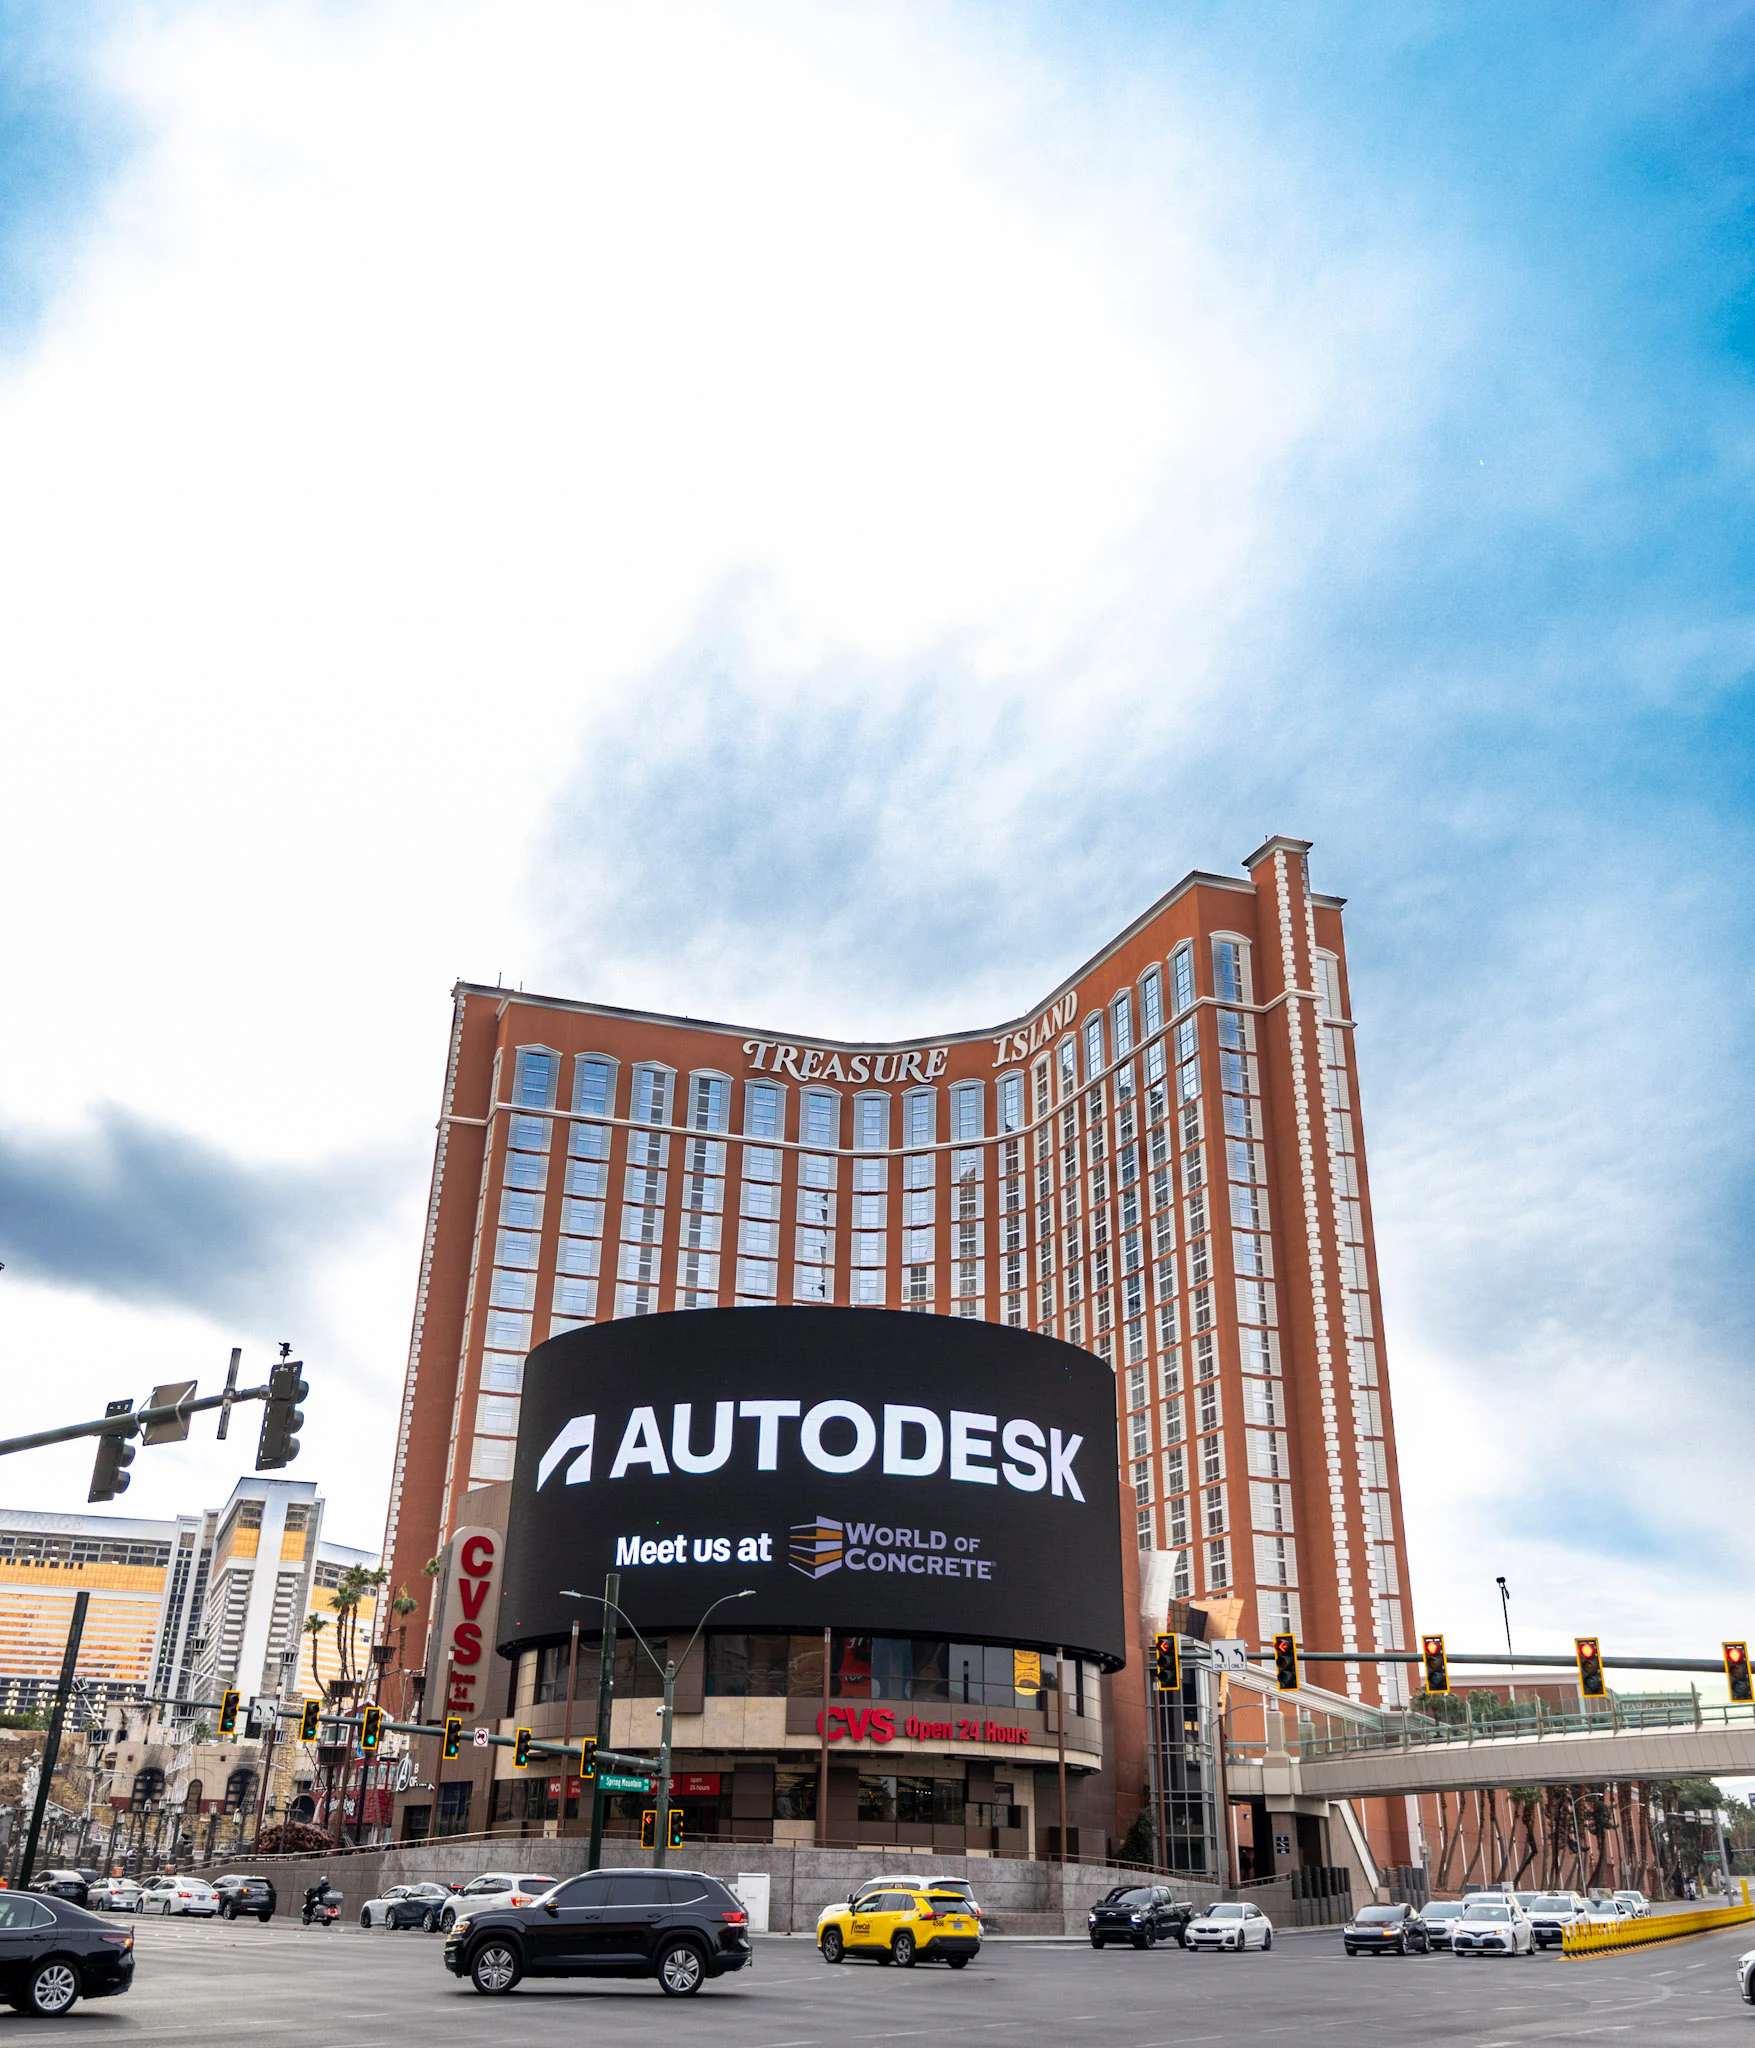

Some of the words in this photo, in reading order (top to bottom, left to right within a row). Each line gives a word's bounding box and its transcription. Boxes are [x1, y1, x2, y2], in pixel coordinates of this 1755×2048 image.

[743, 1040, 949, 1083] TREASURE
[992, 991, 1077, 1068] ISLAND
[609, 1399, 1086, 1503] AUTODESK
[616, 1535, 687, 1567] Meet
[694, 1538, 731, 1563] us
[737, 1533, 772, 1562] at
[845, 1523, 946, 1550] WORLD
[953, 1536, 981, 1553] OF
[845, 1547, 992, 1580] CONCRETE
[454, 1535, 494, 1665] CVS
[450, 1670, 476, 1685] Open
[454, 1687, 468, 1699] 24
[817, 1705, 897, 1743] CVS
[905, 1715, 954, 1743] Open
[958, 1718, 981, 1742] 24
[984, 1720, 1030, 1744] Hours
[606, 1776, 621, 1789] Spring
[621, 1778, 642, 1788] Mountain
